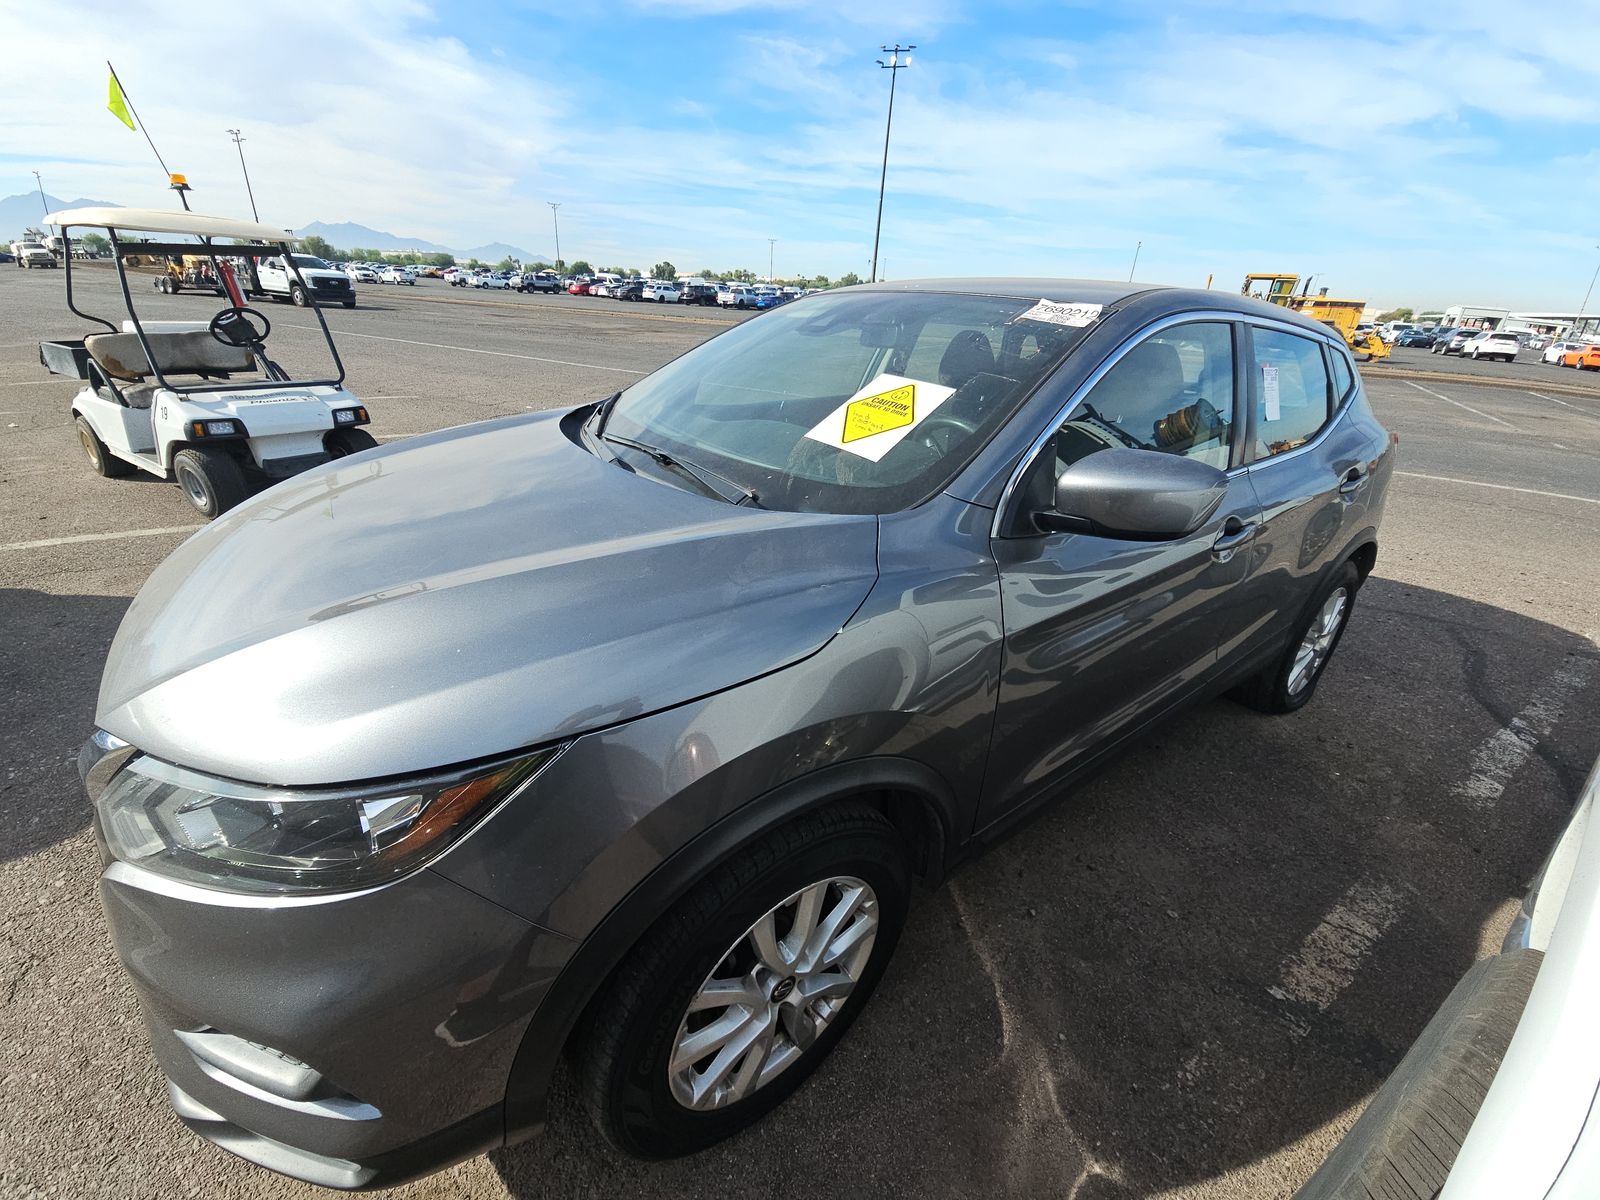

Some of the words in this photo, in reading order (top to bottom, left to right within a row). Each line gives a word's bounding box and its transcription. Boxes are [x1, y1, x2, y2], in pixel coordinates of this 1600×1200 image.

[1036, 303, 1100, 320] 7690212
[861, 401, 882, 410] UNSAFE
[890, 409, 909, 417] DRIVE
[871, 397, 910, 411] CAUTION
[160, 406, 168, 420] 19
